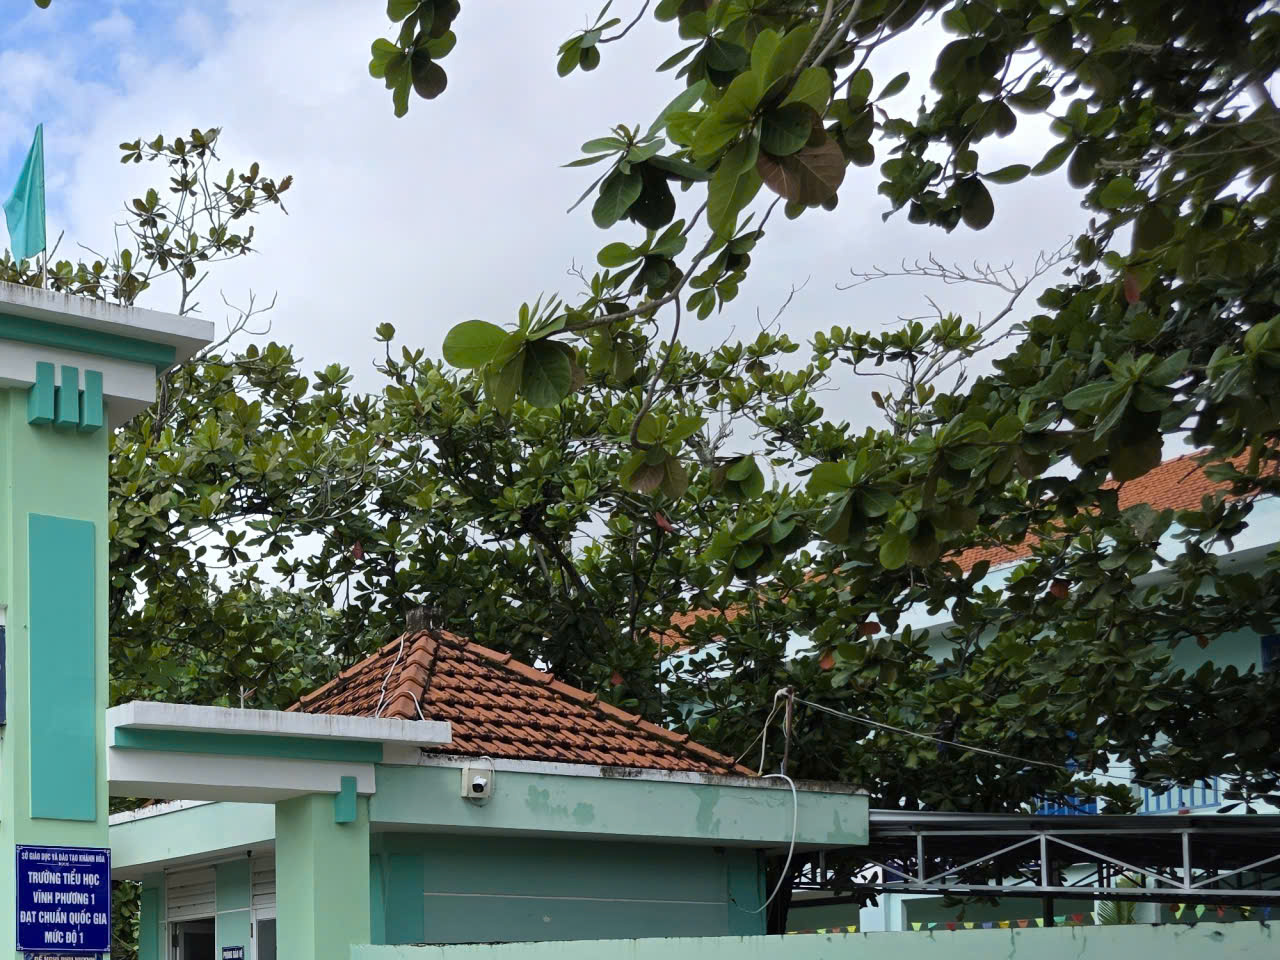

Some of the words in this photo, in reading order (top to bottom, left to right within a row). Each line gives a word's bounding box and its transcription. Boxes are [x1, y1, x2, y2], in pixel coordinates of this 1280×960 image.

[28, 870, 61, 885] TRƯỜNG
[63, 868, 81, 885] TIỂU
[83, 873, 100, 888] HỌC
[33, 890, 53, 904] VĨNH
[55, 891, 89, 905] PHƯƠNG
[91, 894, 95, 905] 1
[20, 911, 36, 925] ĐẠT
[38, 907, 67, 924] CHUẨN
[69, 909, 91, 925] QUỐC
[93, 913, 107, 925] GIA
[44, 929, 64, 944] MỨC
[65, 929, 78, 946] ĐỘ
[79, 933, 84, 944] 1
